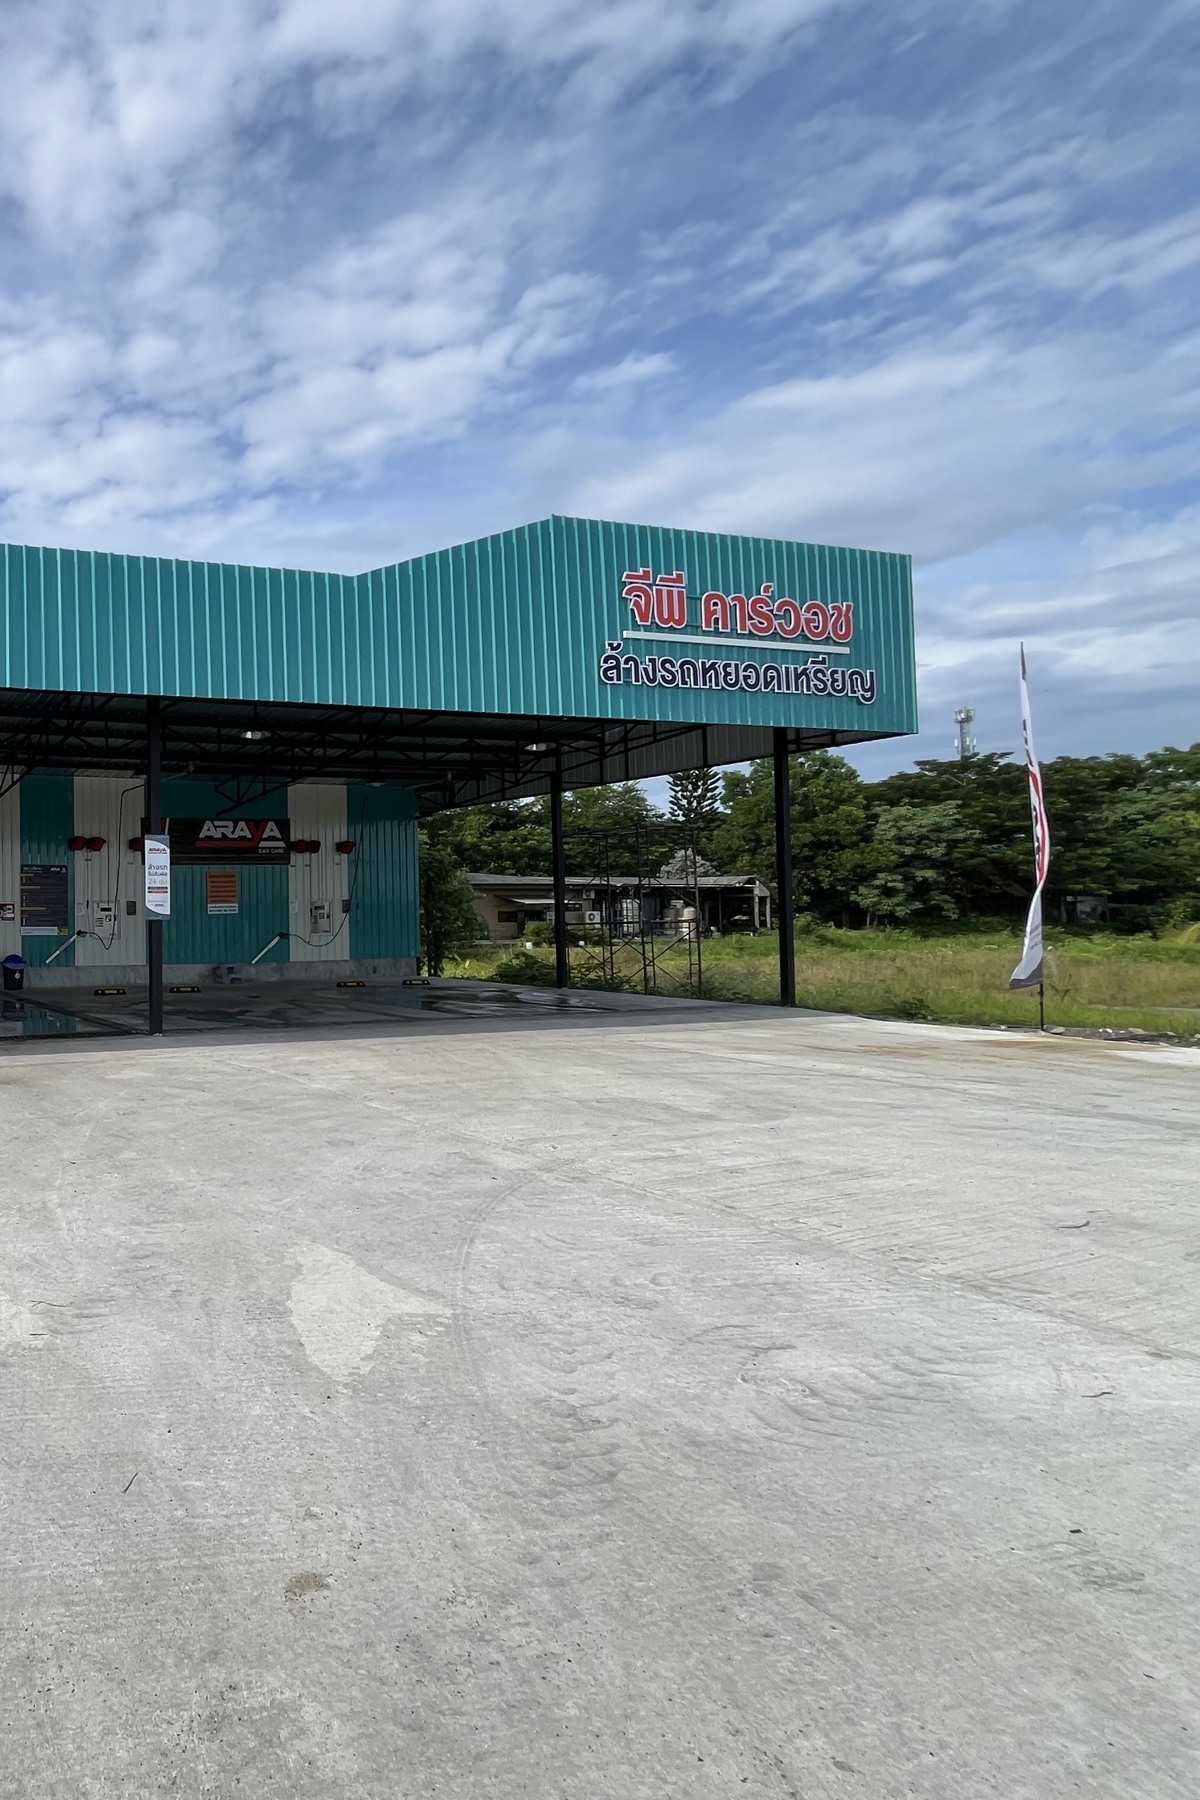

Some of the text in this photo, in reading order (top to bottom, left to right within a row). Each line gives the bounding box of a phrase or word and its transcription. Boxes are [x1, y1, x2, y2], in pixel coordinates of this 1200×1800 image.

[622, 567, 854, 643] จีพี คาร์วอช
[600, 641, 876, 704] ล้างรถหยอดเหรียญ
[199, 820, 282, 840] ARAYA
